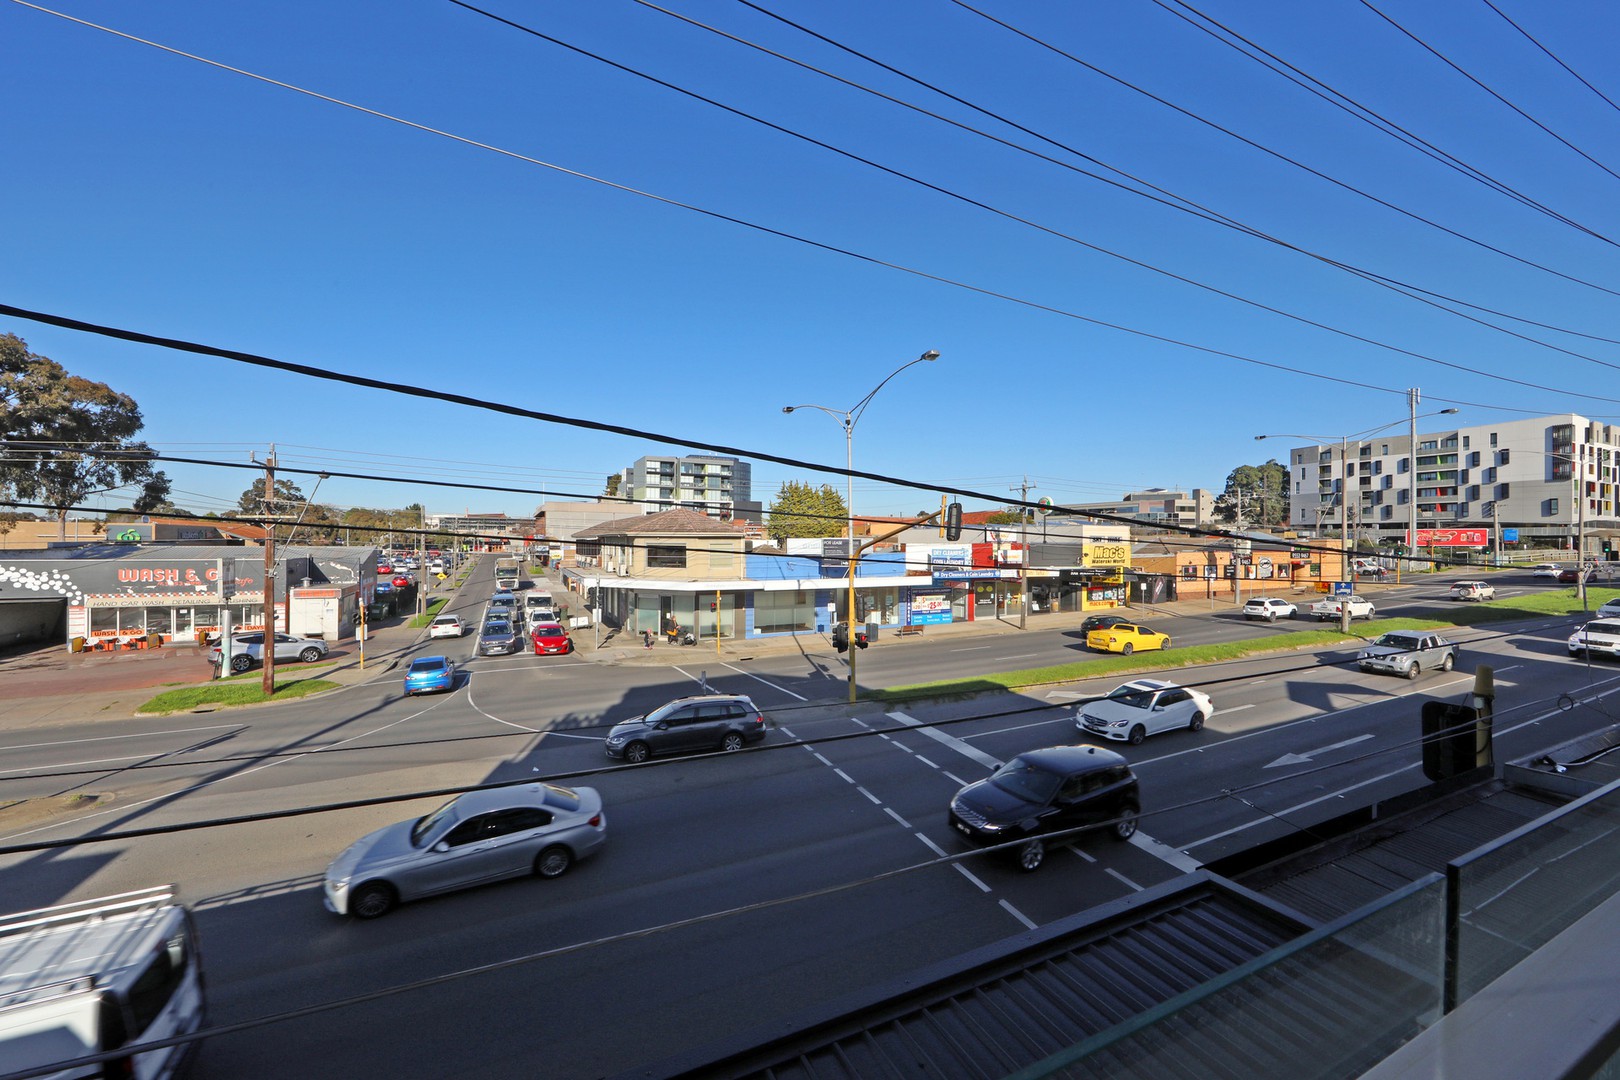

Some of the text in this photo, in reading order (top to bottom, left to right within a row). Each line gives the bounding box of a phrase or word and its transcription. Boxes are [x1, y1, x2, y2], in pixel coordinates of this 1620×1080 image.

[1093, 546, 1125, 559] Mac's
[118, 568, 178, 582] WASH
[185, 568, 200, 582] &
